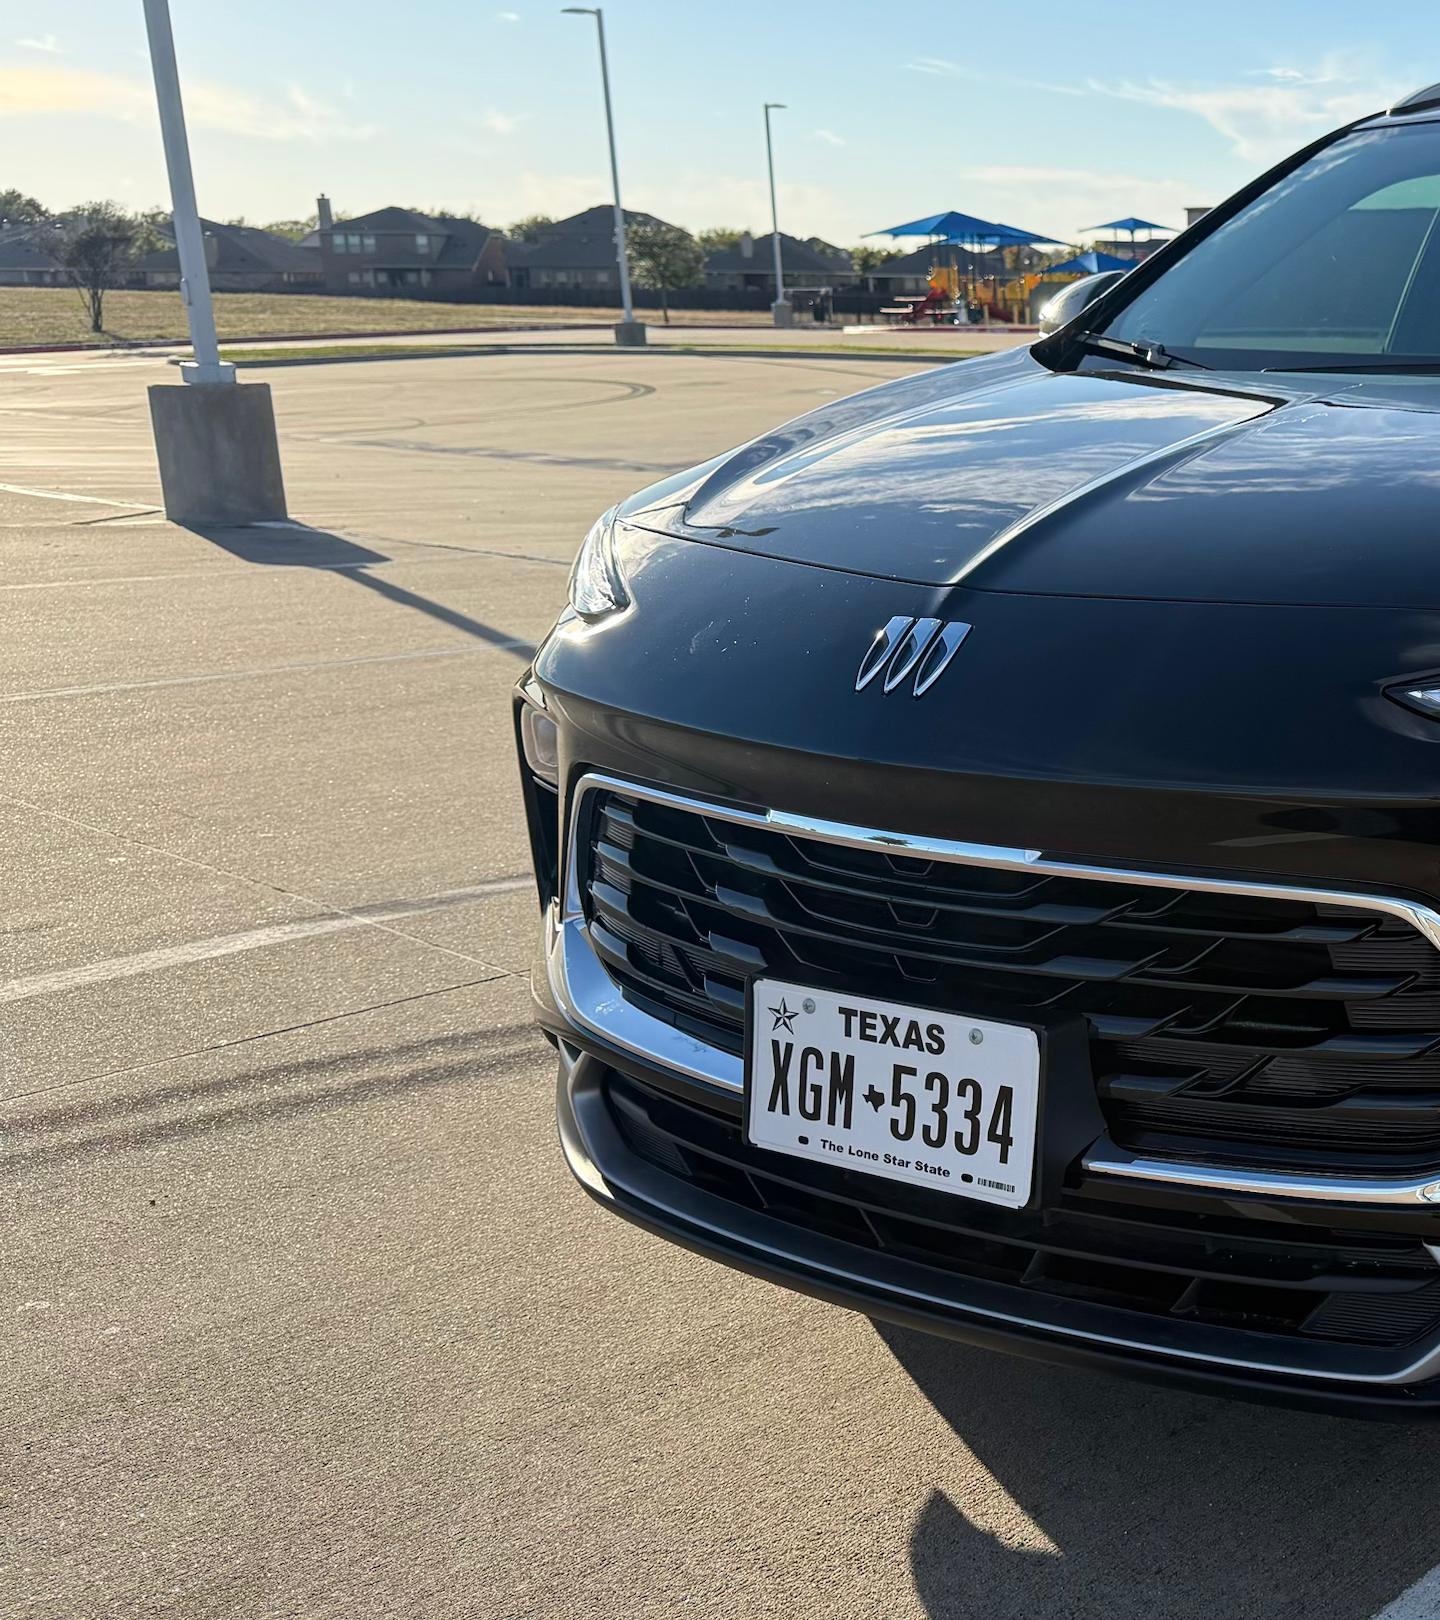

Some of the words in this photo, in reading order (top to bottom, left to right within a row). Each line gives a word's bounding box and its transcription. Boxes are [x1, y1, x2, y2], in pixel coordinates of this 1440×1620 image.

[838, 1006, 945, 1055] TEXAS
[768, 1039, 855, 1130] XGM
[890, 1064, 1014, 1164] 5334
[821, 1138, 843, 1153] The
[848, 1146, 879, 1161] Lone
[884, 1153, 910, 1168] Star
[915, 1160, 950, 1178] State
